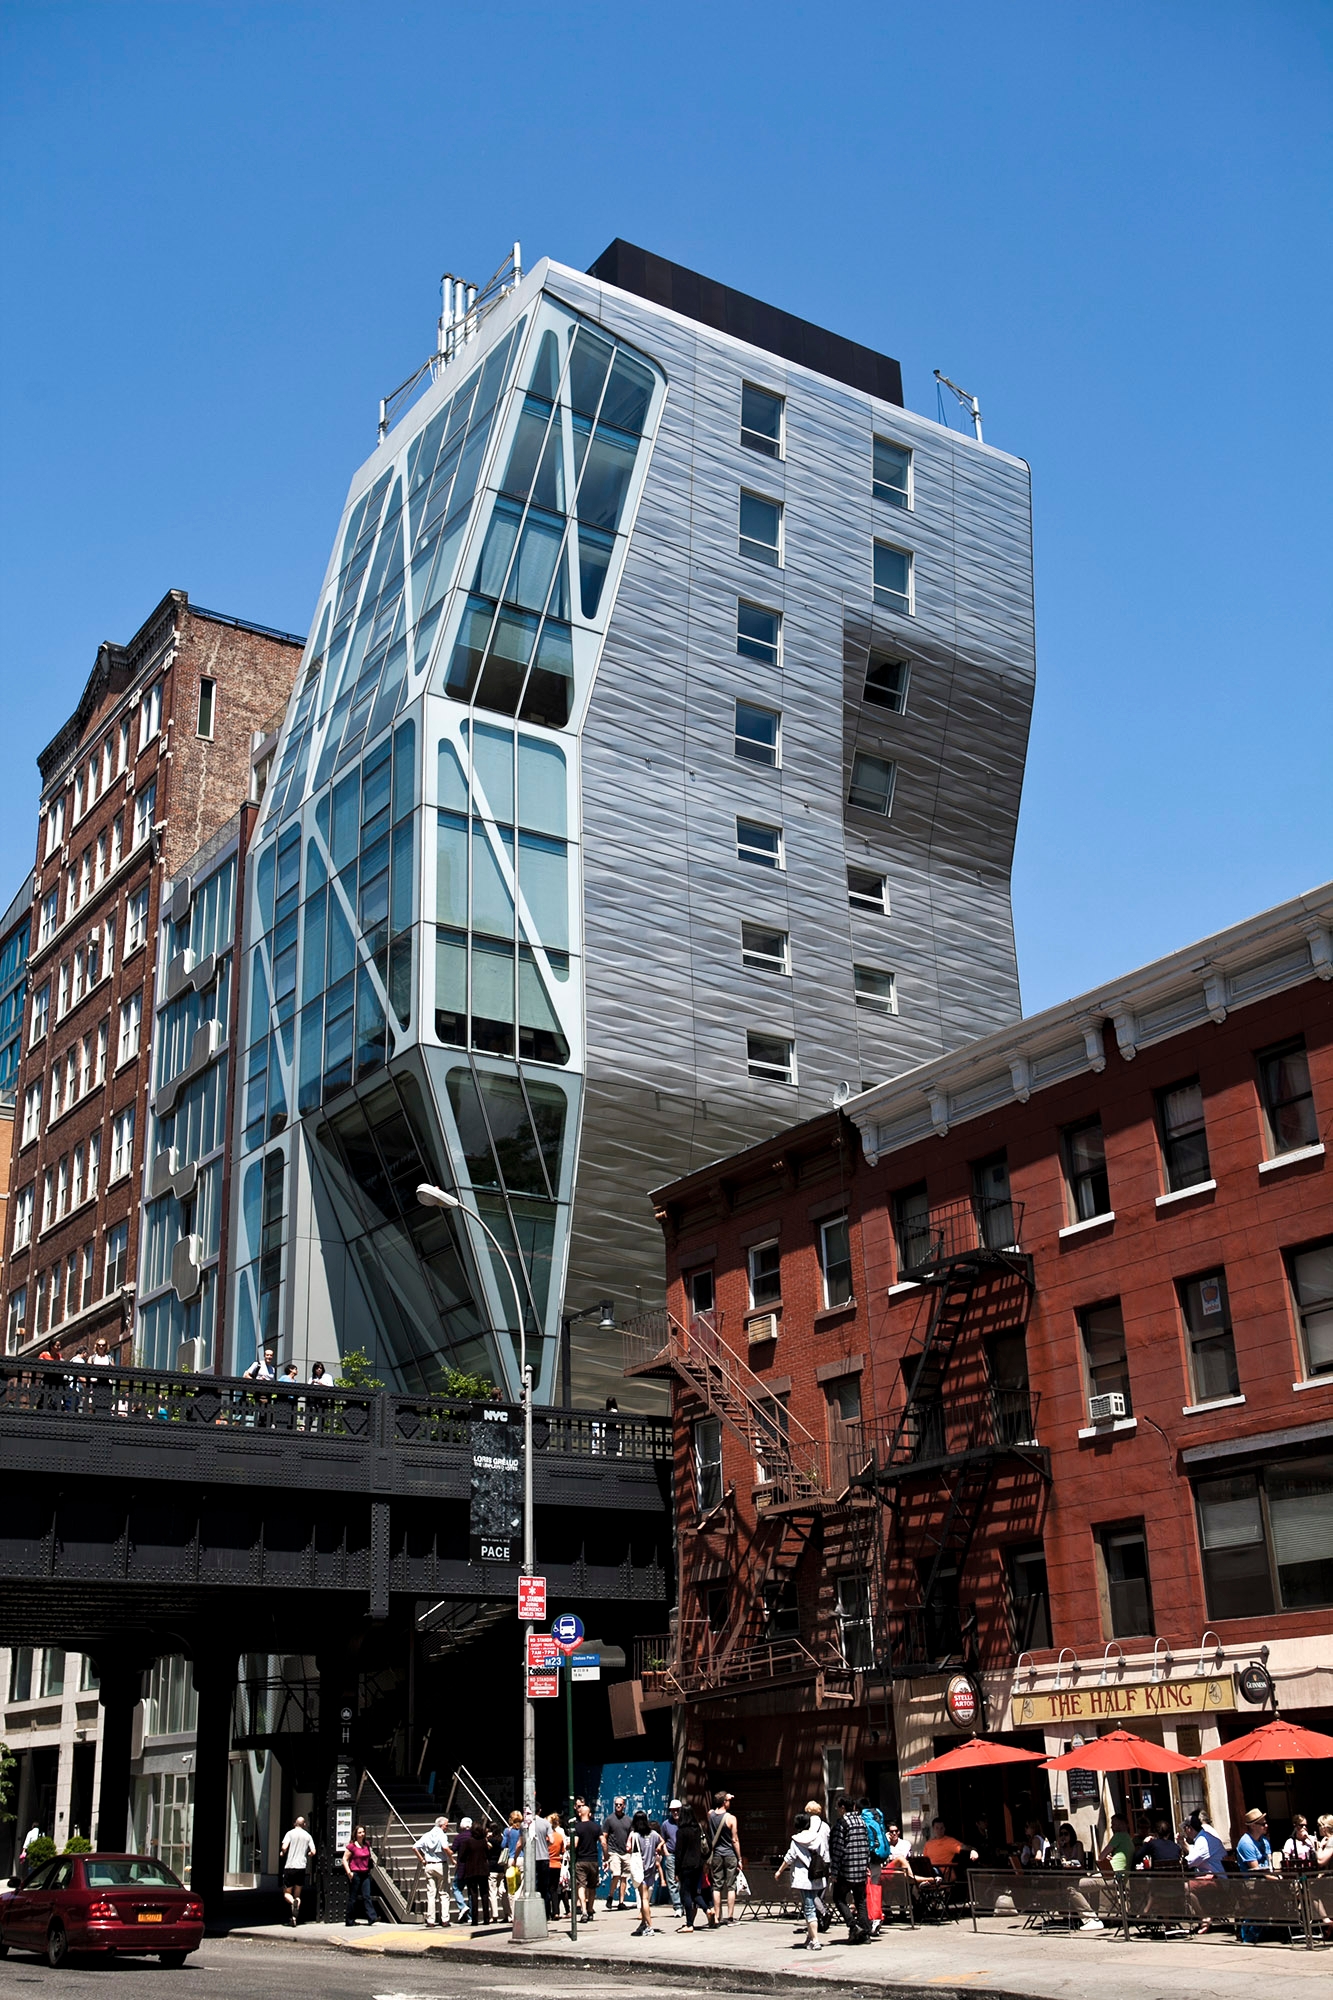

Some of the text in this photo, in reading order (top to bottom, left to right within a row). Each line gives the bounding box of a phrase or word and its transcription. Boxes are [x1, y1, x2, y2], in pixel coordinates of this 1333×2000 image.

[484, 1410, 508, 1422] NYC
[481, 1545, 510, 1558] PACE
[545, 1656, 562, 1666] M23
[1246, 1681, 1267, 1689] GUINNESS
[1048, 1684, 1192, 1717] THE HALF KING
